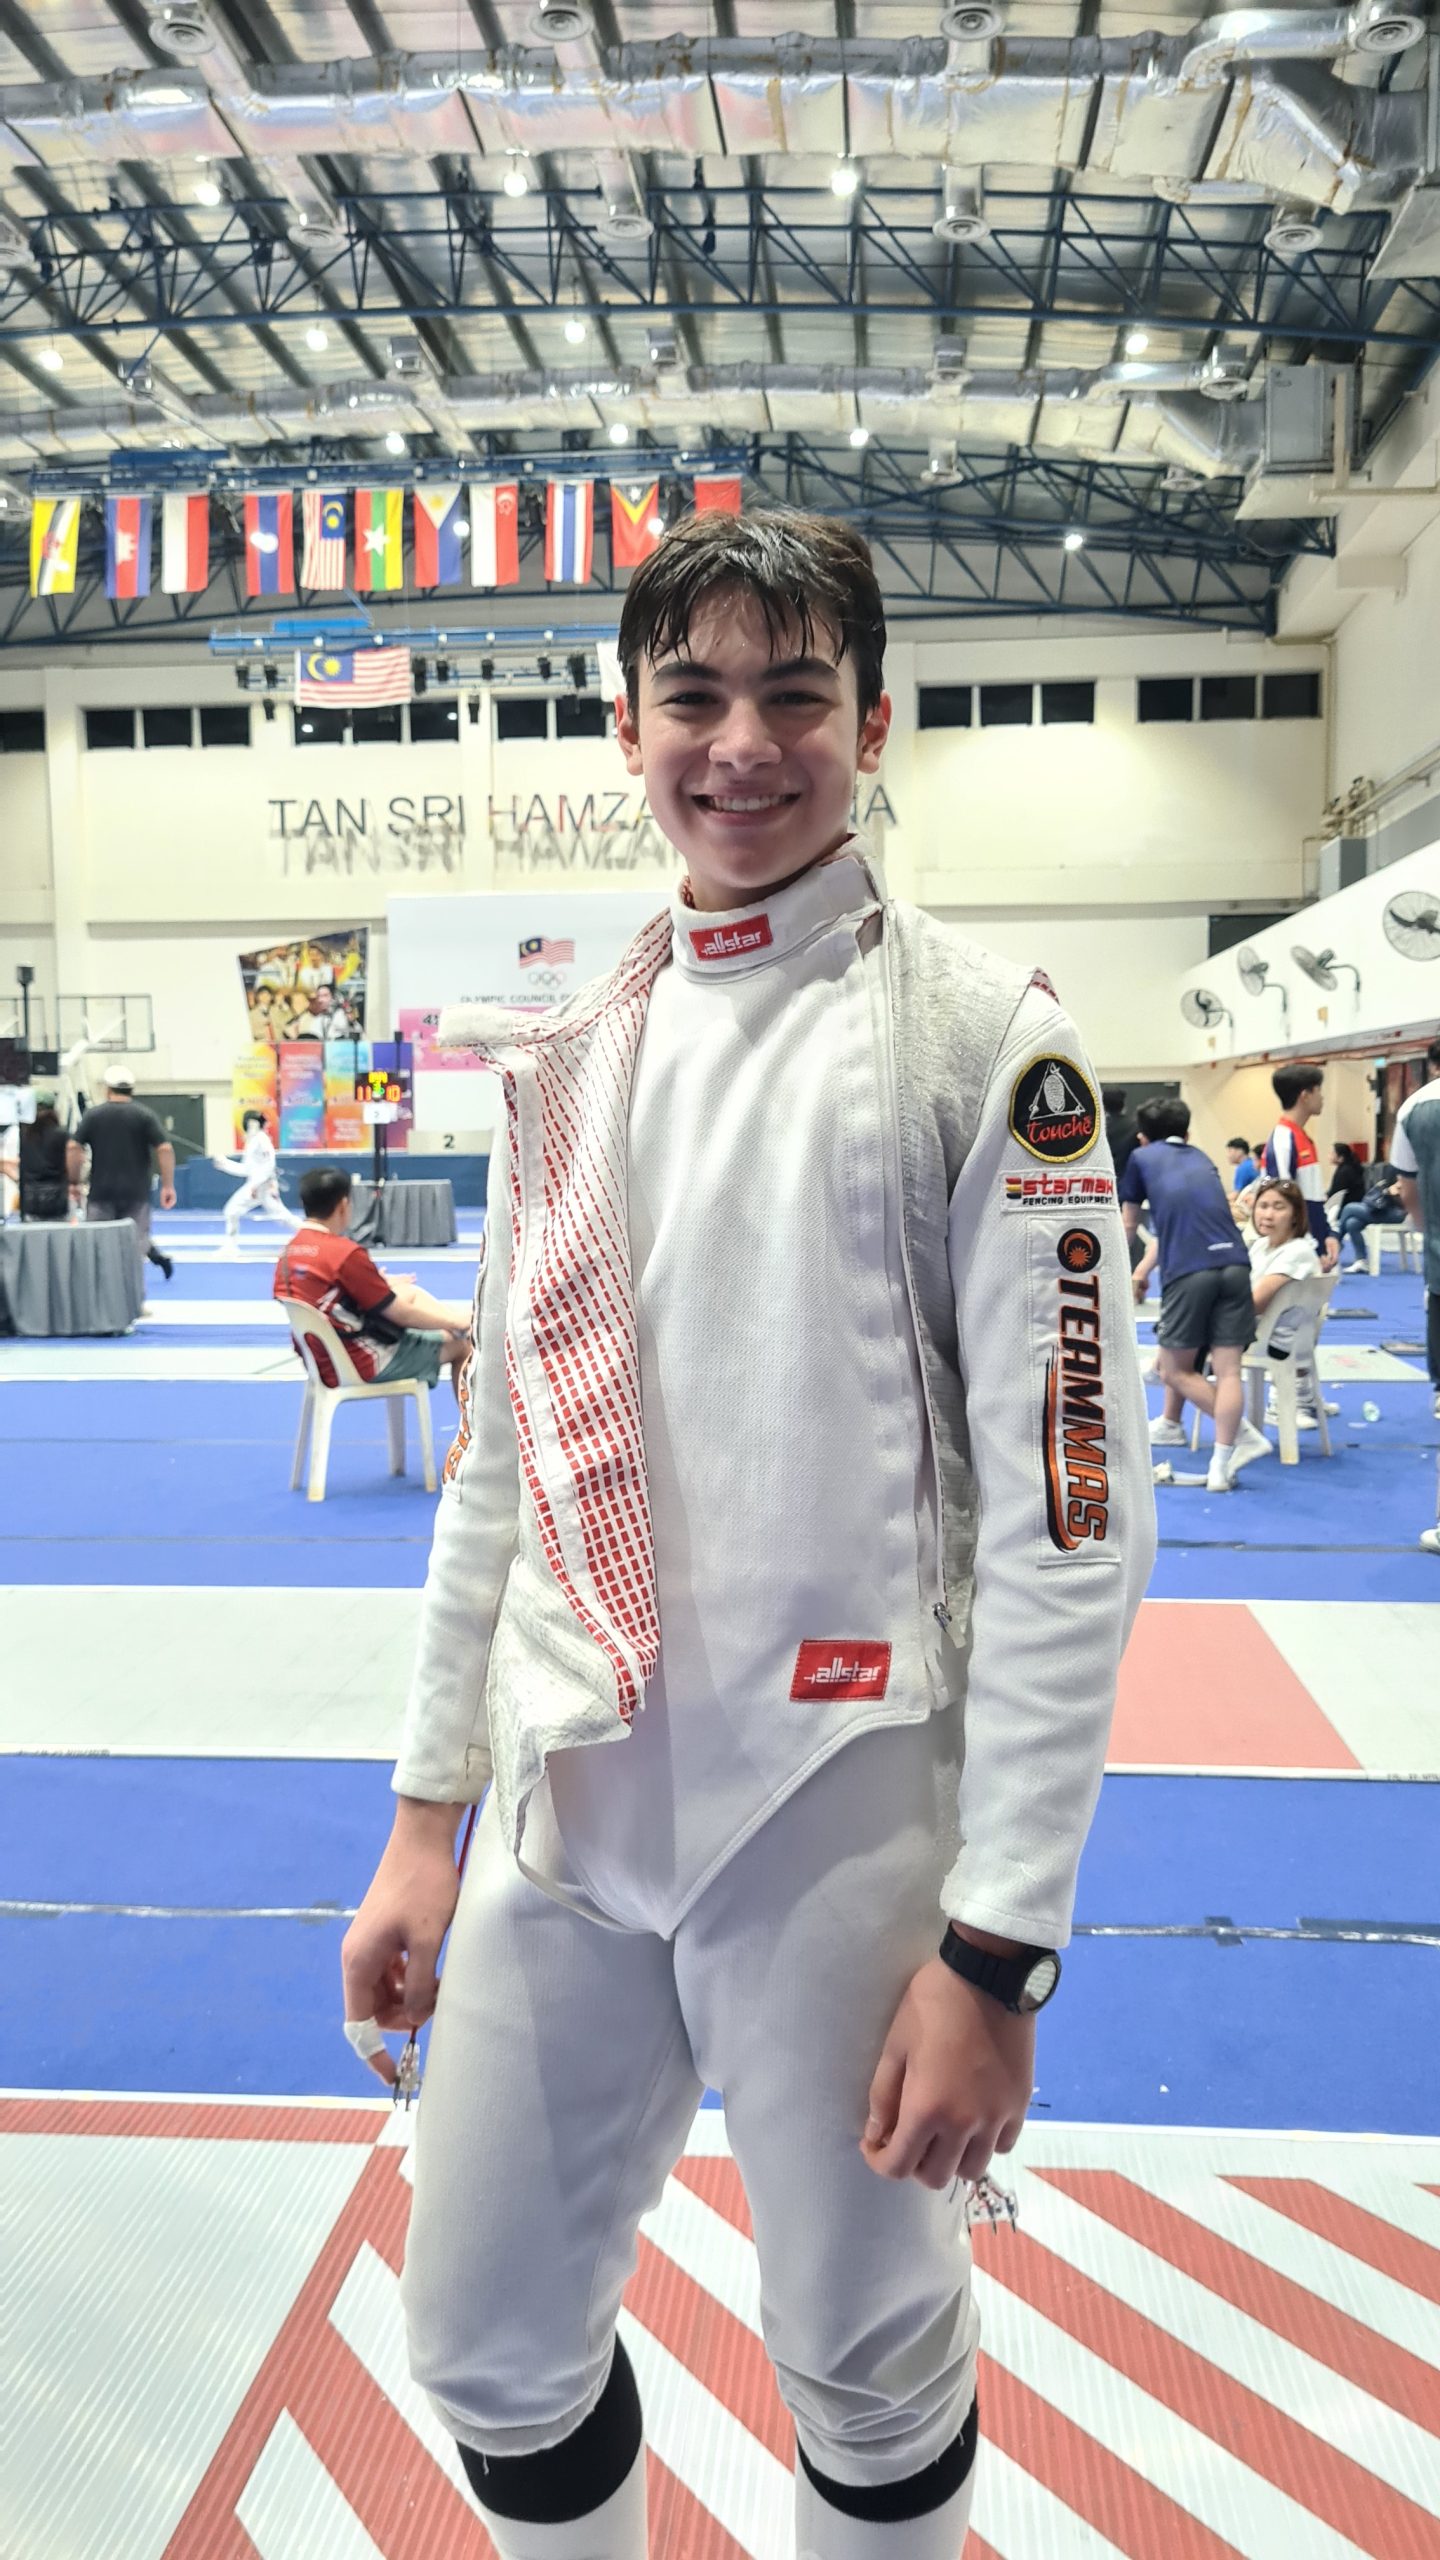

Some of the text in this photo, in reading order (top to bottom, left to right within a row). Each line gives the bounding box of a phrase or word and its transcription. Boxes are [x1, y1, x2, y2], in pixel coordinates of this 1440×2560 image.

[268, 798, 366, 838] TAN
[387, 795, 465, 837] SRI
[704, 931, 761, 955] allstar
[444, 1134, 455, 1149] 2
[1023, 1197, 1064, 1206] FENCING
[815, 1657, 881, 1683] allstar
